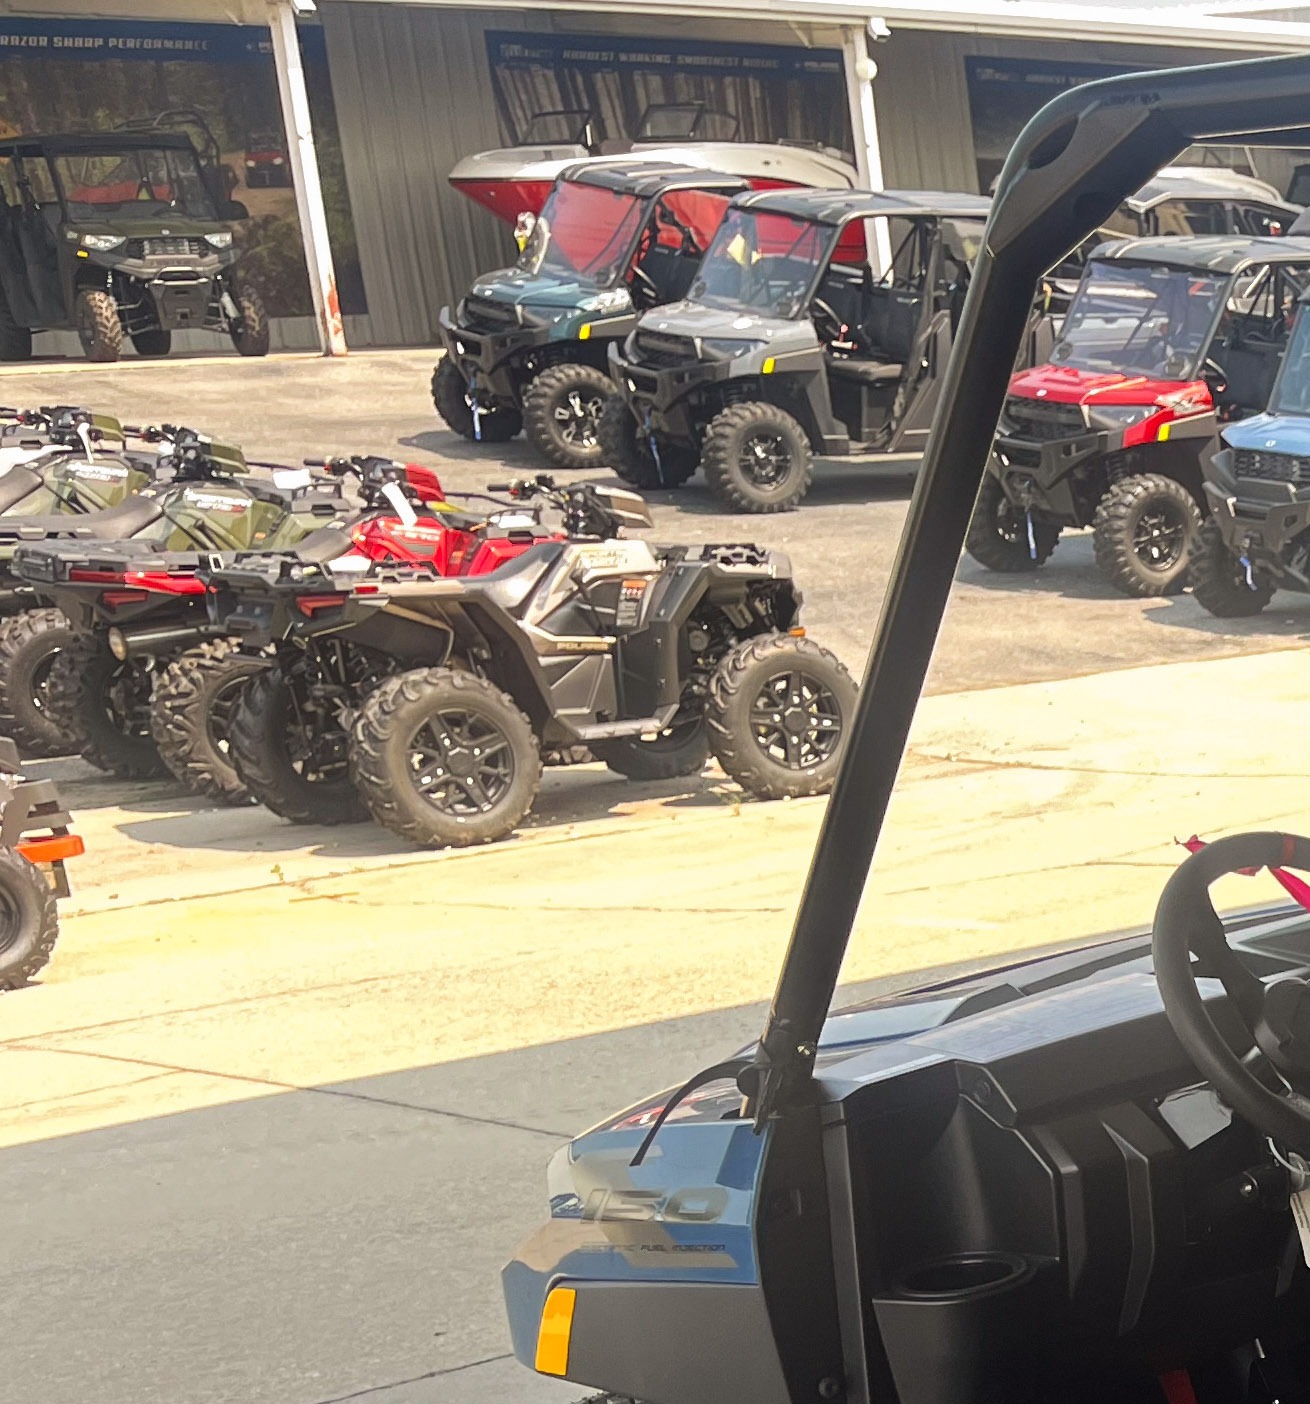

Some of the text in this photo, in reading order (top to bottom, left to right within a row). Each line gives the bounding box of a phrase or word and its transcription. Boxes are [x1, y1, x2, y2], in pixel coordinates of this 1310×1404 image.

[0, 35, 208, 50] RAZOR SHARP PERFORMANCE
[641, 1244, 665, 1252] FUEL
[672, 1244, 726, 1252] INJECTION
